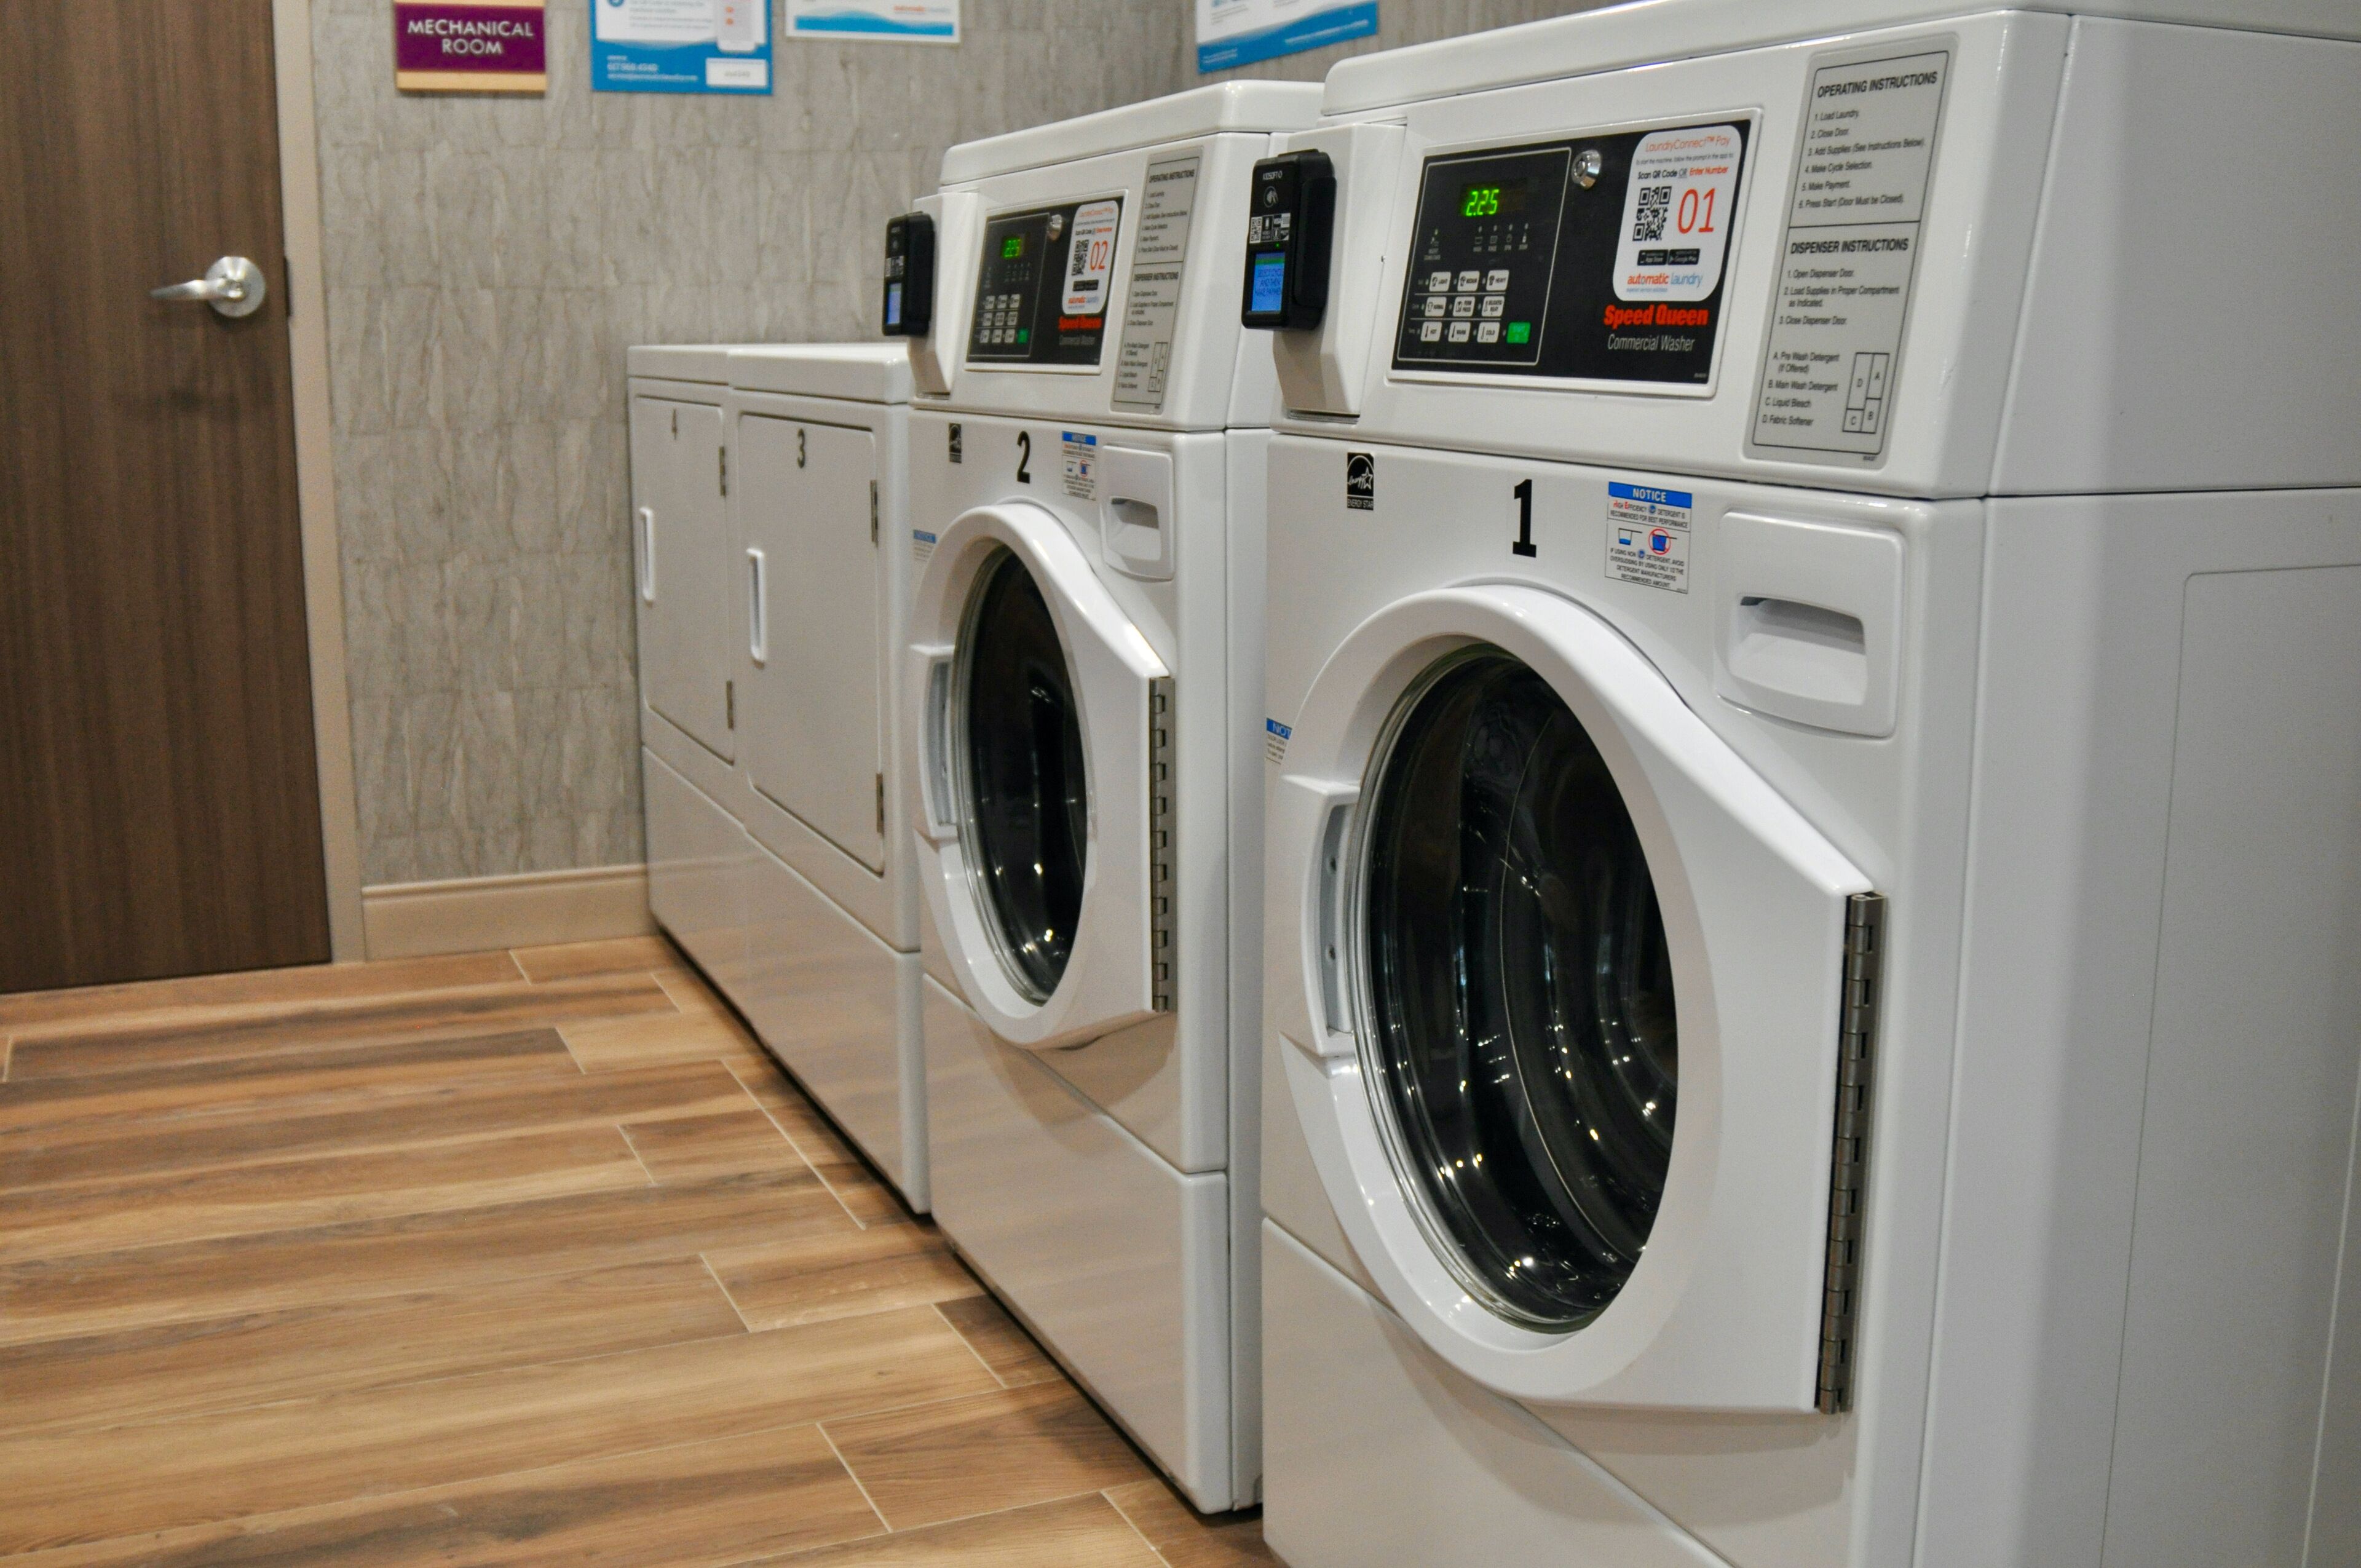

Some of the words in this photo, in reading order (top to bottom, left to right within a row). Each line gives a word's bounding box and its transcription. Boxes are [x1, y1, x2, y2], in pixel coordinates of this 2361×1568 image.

[408, 19, 534, 36] MECHANICAL
[441, 38, 503, 55] ROOM
[1817, 81, 1868, 98] OPERATING
[1869, 71, 1938, 92] INSTRUCTIONS
[1820, 112, 1835, 121] Load
[1817, 129, 1833, 138] Close
[1716, 135, 1731, 148] Pay
[1815, 147, 1826, 156] Add
[1827, 145, 1851, 156] Supplies
[1867, 140, 1901, 151] Instructions
[1638, 171, 1651, 180] Scan
[1652, 170, 1661, 179] QR
[1662, 169, 1677, 178] Code
[1679, 168, 1687, 178] OR
[1690, 167, 1704, 176] Enter
[1705, 165, 1728, 175] Number
[1828, 163, 1844, 173] Cycle
[1466, 189, 1500, 216] 2.25
[1805, 199, 1821, 208] Press
[1855, 196, 1870, 205] Must
[1677, 187, 1716, 234] 01
[1790, 240, 1840, 254] DISPENSER
[1841, 238, 1909, 252] INSTRUCTIONS
[1090, 240, 1109, 271] 02
[1627, 272, 1669, 285] automatic
[1671, 272, 1703, 288] laundry
[1793, 269, 1809, 279] Open
[1809, 269, 1838, 279] Dispenser
[1790, 287, 1805, 295] Load
[1806, 285, 1829, 296] Supplies
[1837, 285, 1857, 296] Proper
[1858, 285, 1900, 296] Compartment
[1604, 304, 1655, 330] Speed
[1655, 303, 1709, 327] Queen
[1786, 315, 1801, 325] Close
[1803, 315, 1832, 325] Dispenser
[1607, 333, 1659, 350] Commercial
[1660, 335, 1696, 351] Washer
[1809, 352, 1840, 364] Detergent
[1857, 378, 1863, 387] D
[1875, 371, 1880, 380] A
[1808, 381, 1838, 393] Detergent
[1769, 414, 1787, 424] Fabric
[1788, 416, 1814, 426] Softener
[1850, 416, 1857, 426] C
[1867, 411, 1873, 420] B
[797, 428, 806, 469] 3
[1017, 431, 1030, 484] 2
[1632, 488, 1667, 502] NOTICE
[1513, 478, 1537, 558] 1
